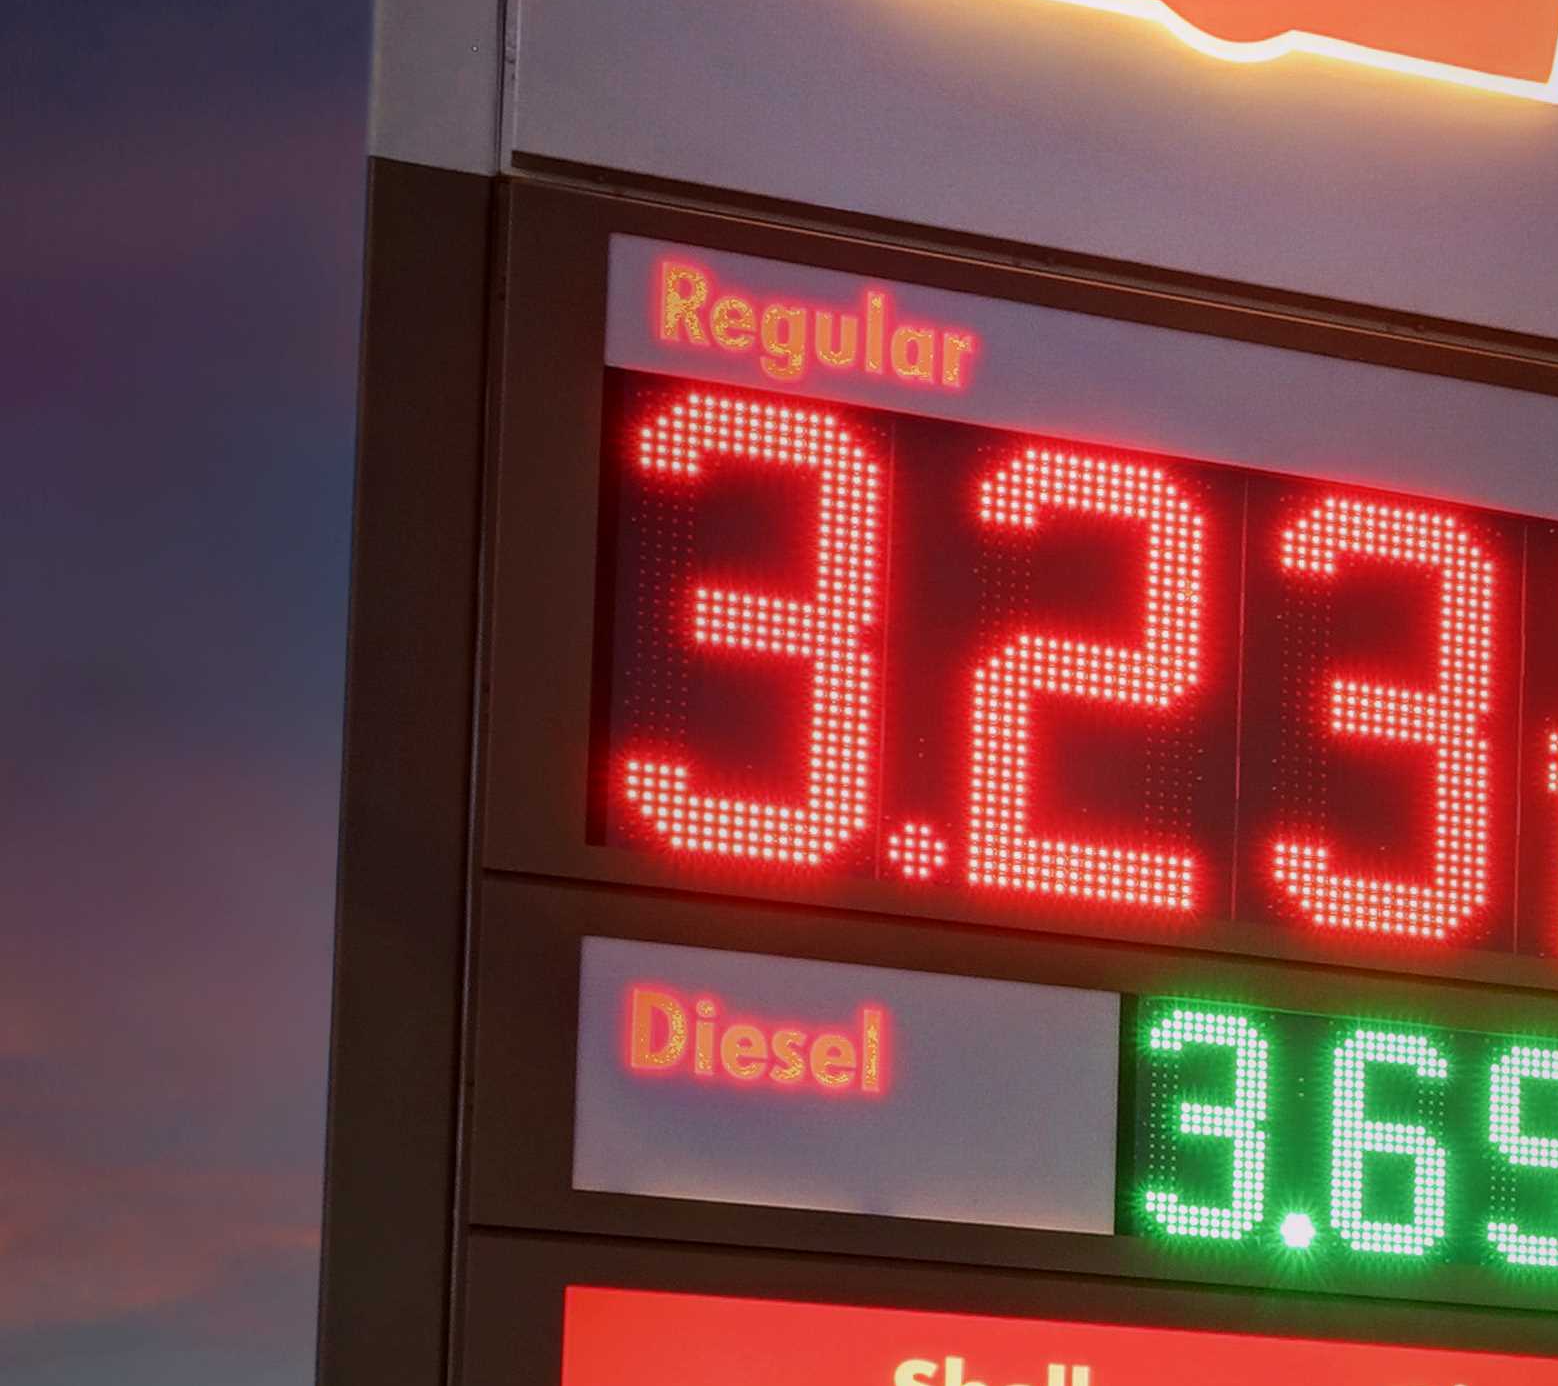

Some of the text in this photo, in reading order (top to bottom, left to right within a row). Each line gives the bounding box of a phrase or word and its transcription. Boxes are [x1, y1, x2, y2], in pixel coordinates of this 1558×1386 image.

[659, 261, 975, 388] Regular
[625, 390, 1497, 944] 3.23
[628, 985, 884, 1093] Diesel
